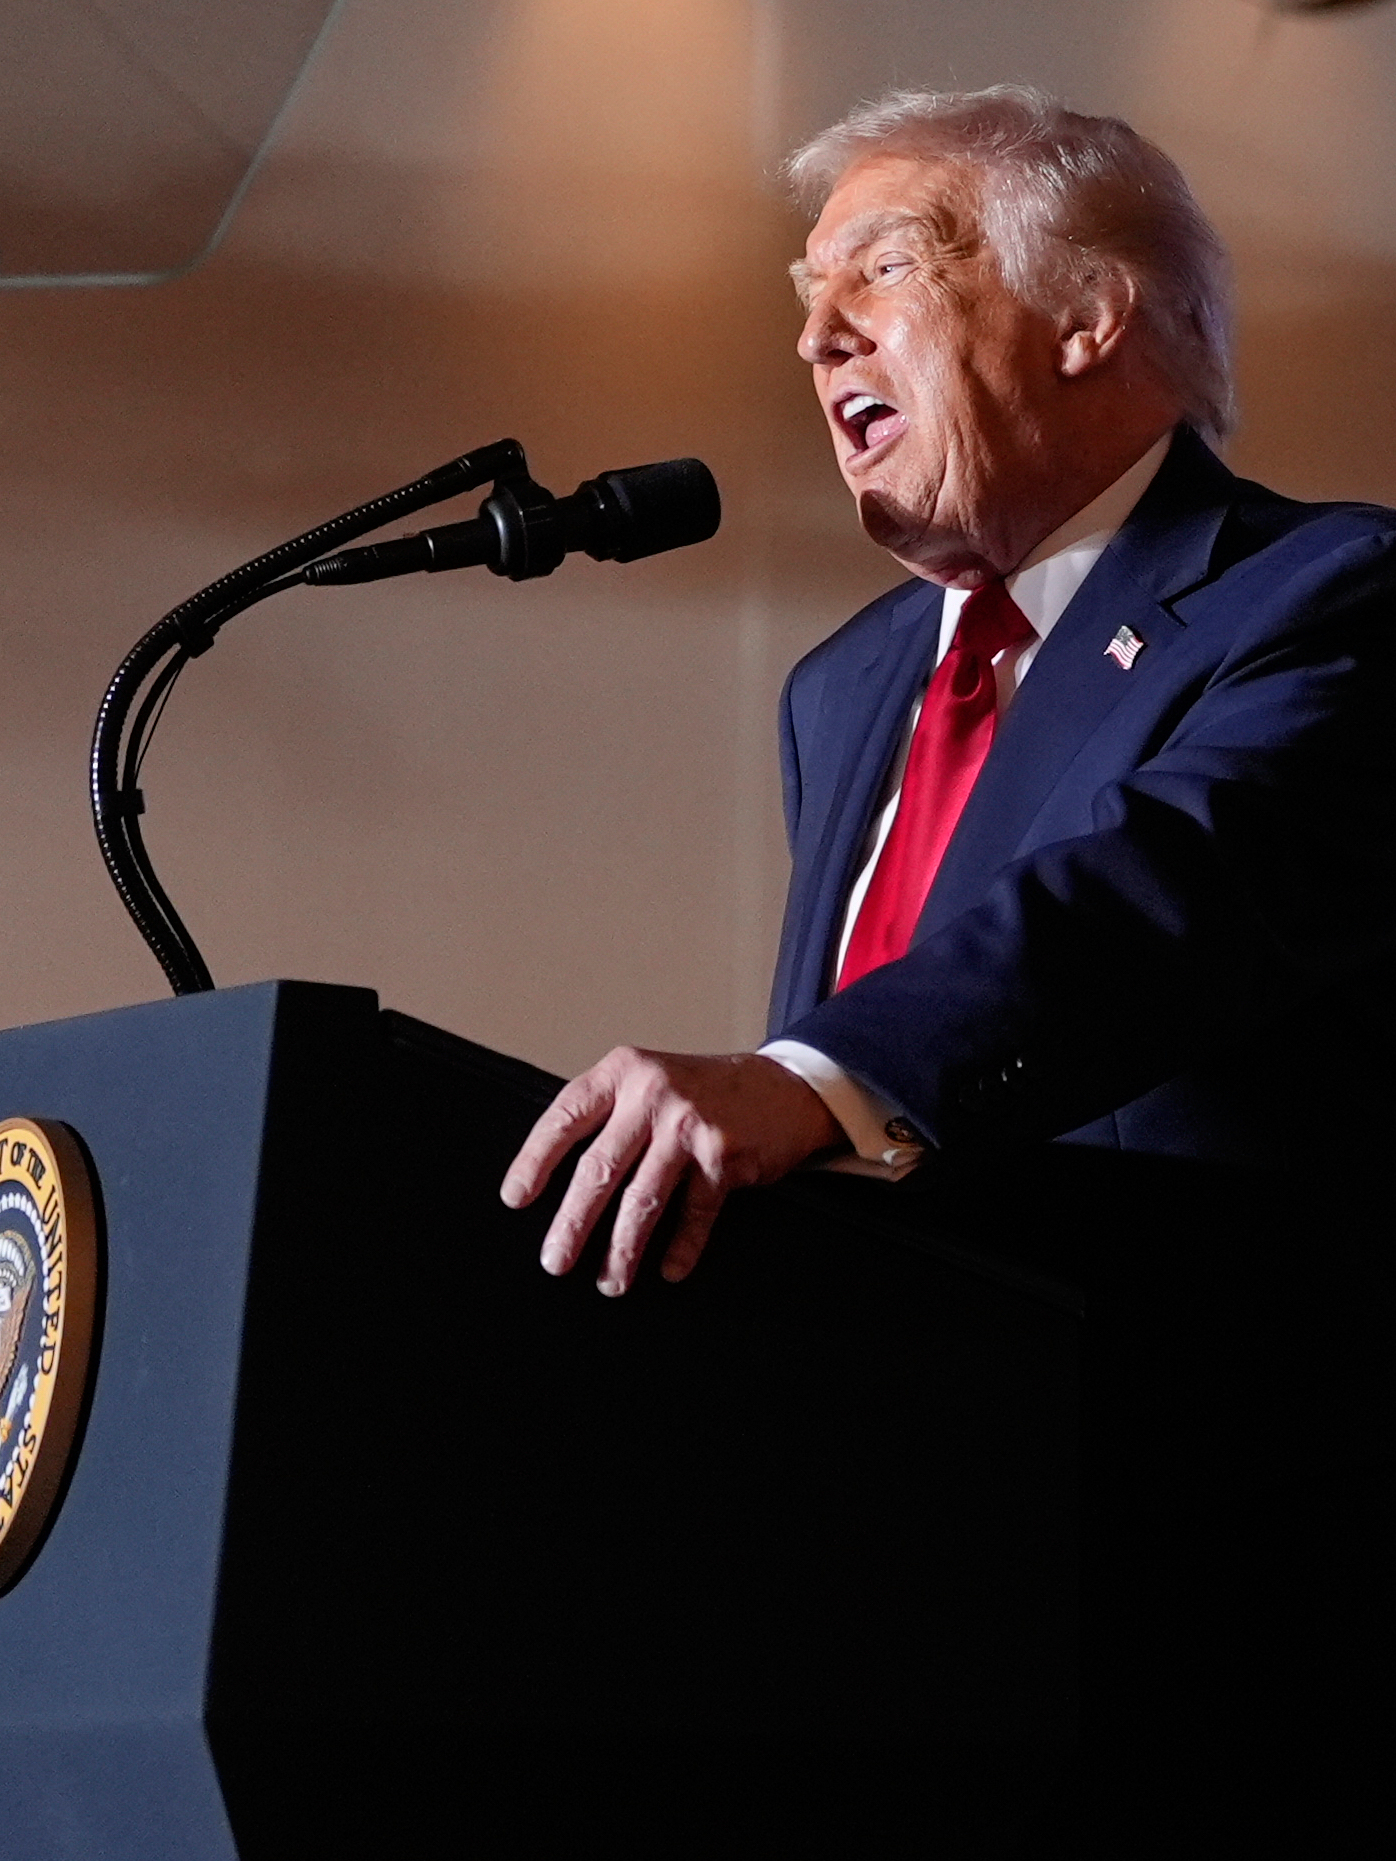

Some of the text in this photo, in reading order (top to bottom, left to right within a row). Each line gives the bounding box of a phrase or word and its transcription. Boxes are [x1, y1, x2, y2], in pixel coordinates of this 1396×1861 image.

[10, 1141, 27, 1167] OF
[26, 1147, 46, 1191] THE
[41, 1184, 62, 1376] UNITED
